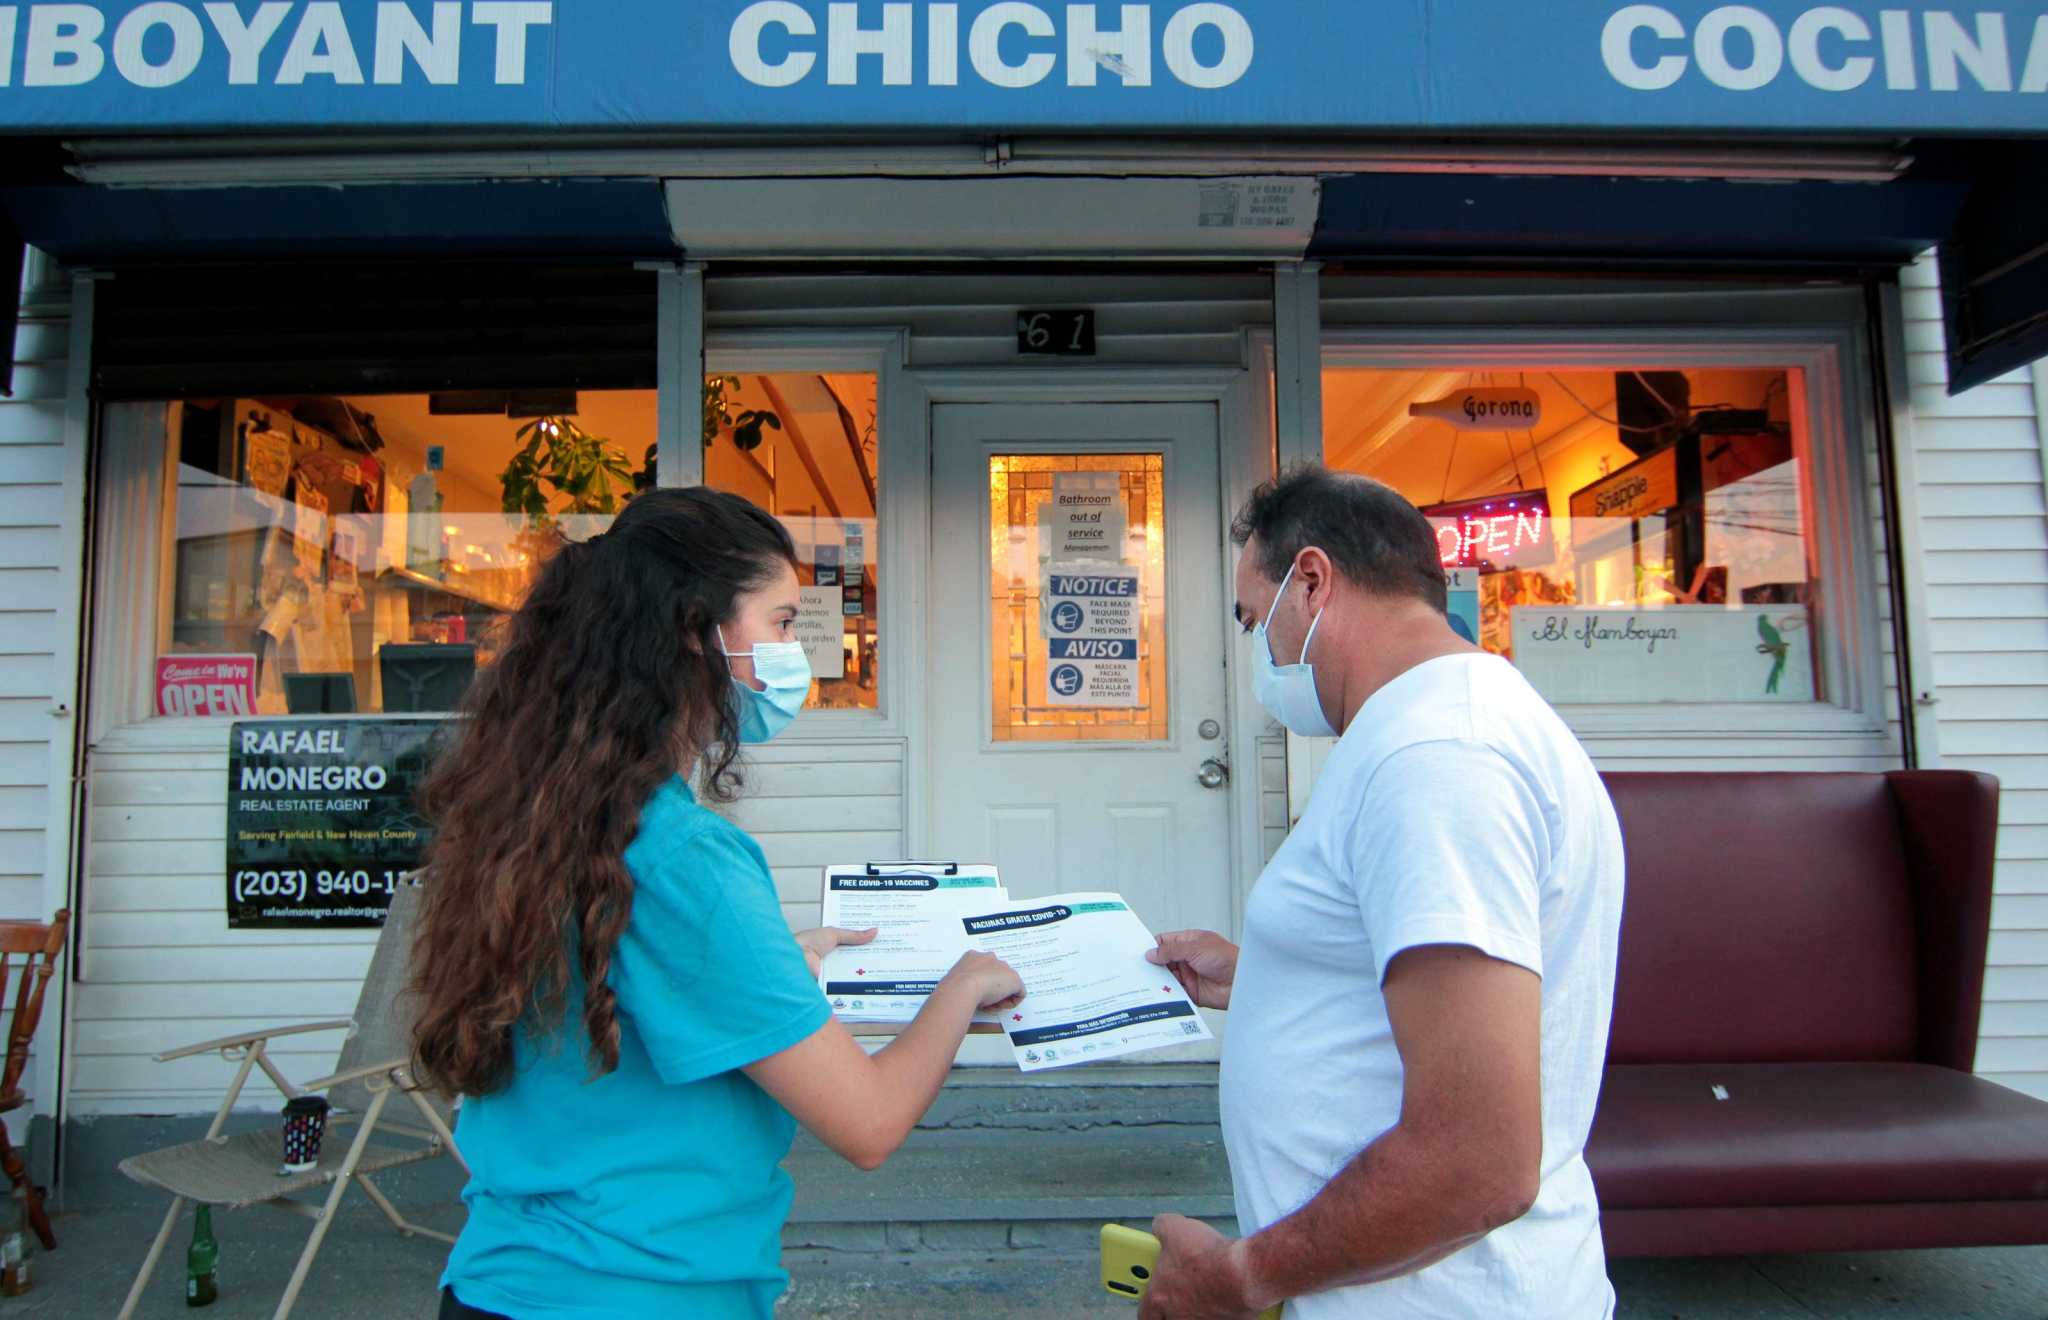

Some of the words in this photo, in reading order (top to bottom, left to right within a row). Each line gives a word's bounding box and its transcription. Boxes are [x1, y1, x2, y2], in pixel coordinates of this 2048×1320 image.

[0, 0, 552, 88] BOYANT
[728, 0, 1254, 88] CHICHO
[1463, 395, 1533, 422] Corona
[1058, 495, 1112, 505] Bathroom
[1595, 476, 1648, 517] Snapple
[1070, 512, 1088, 521] out
[1090, 511, 1102, 521] of
[1068, 528, 1104, 538] service
[1437, 508, 1544, 563] OPEN
[1058, 578, 1130, 595] NOTICE
[799, 607, 830, 617] ndemos
[1091, 608, 1130, 617] REQUIRED
[1064, 641, 1123, 657] AVISO
[162, 684, 249, 717] OPEN
[241, 730, 344, 754] RAFAEL
[240, 765, 387, 791] MONEGRO
[240, 800, 274, 811] REAL
[276, 800, 323, 811] ESTATE
[325, 799, 371, 811] AGENT
[239, 830, 276, 841] Serving
[279, 830, 315, 840] Fairfield
[327, 830, 347, 839] New
[350, 830, 380, 839] Haven
[382, 829, 417, 841] County
[234, 870, 307, 902] (203)
[839, 879, 857, 887] FREE
[858, 879, 894, 887] COVID-19
[895, 879, 930, 887] VACCINES
[262, 906, 388, 919] rafaelmonegro.realtor@gm
[970, 918, 1006, 930] VACUNAS
[1006, 914, 1032, 925] GRATIS
[1033, 908, 1067, 922] COVID-19
